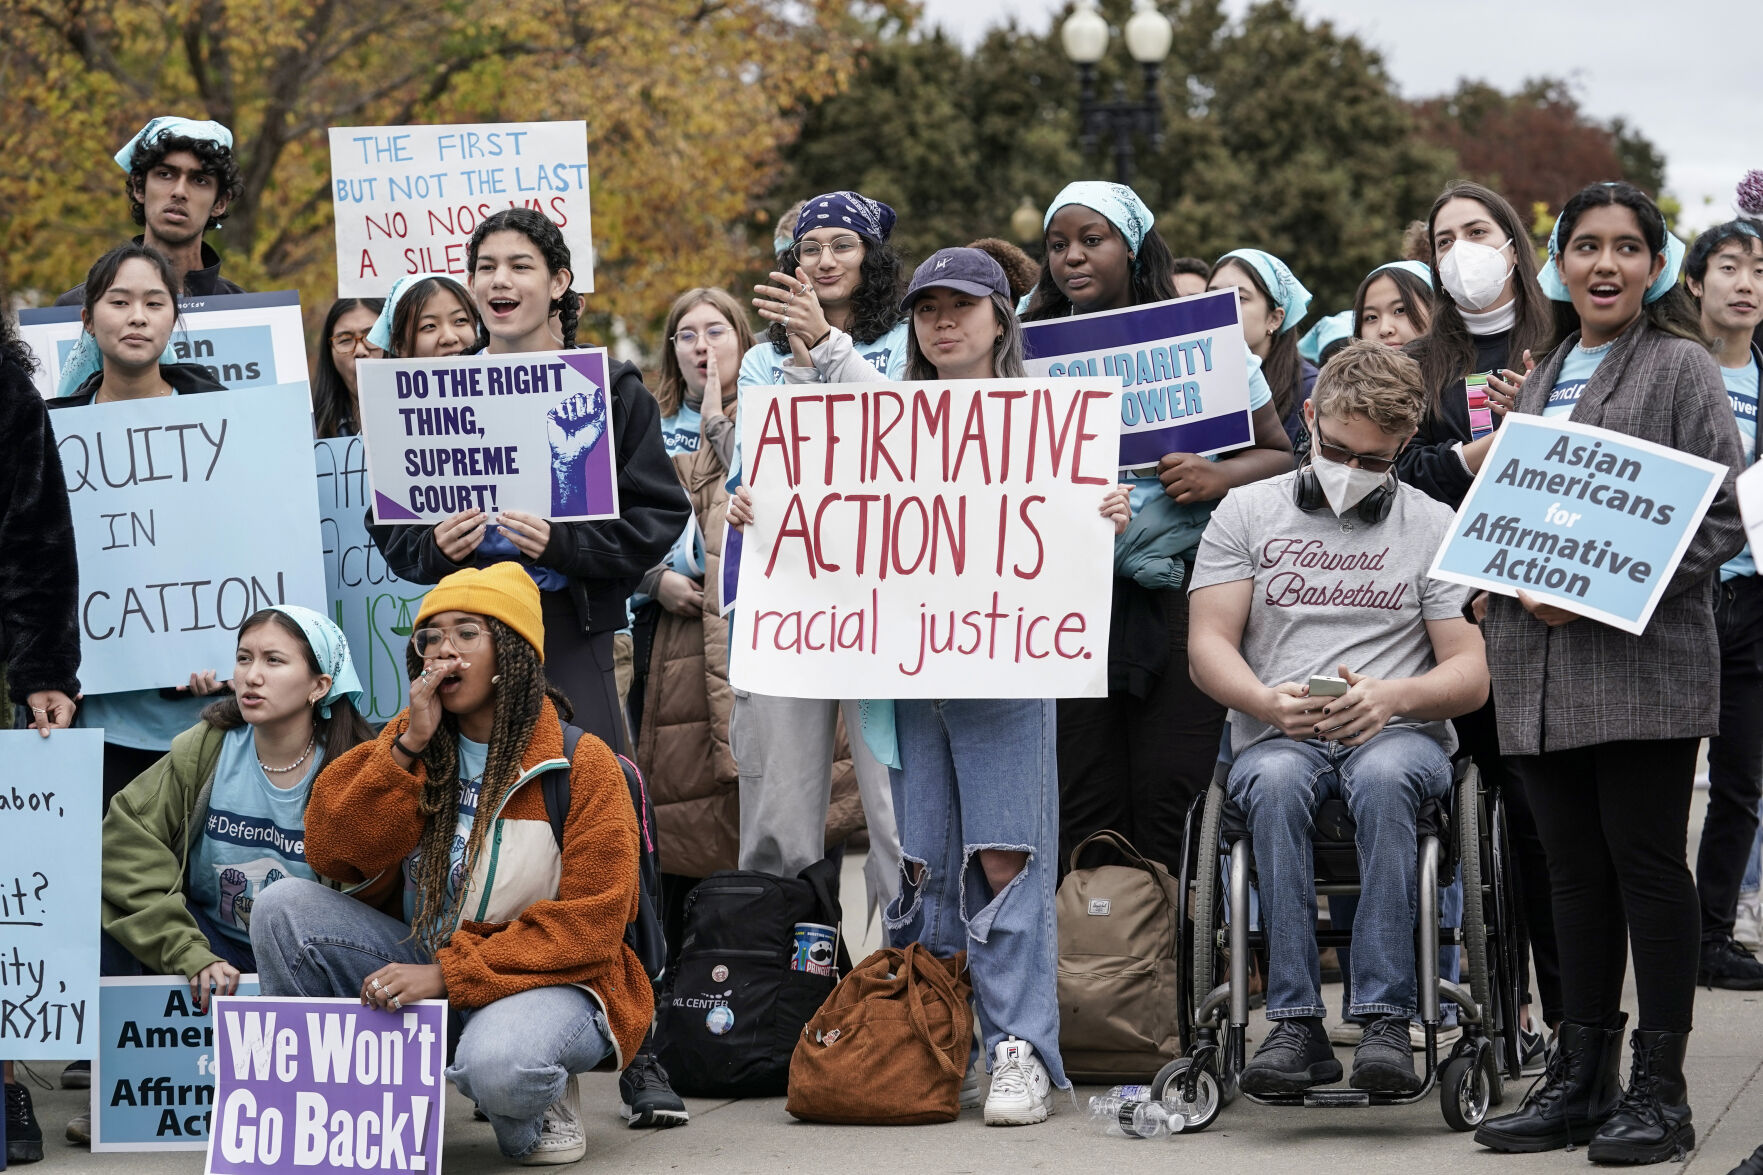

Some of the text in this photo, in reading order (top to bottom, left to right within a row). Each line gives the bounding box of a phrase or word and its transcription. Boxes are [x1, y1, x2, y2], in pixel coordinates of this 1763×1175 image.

[353, 132, 528, 164] THE FIRST
[336, 163, 587, 203] BUT NOT THE LAST
[365, 211, 408, 240] NO
[360, 242, 471, 278] A SILE
[395, 363, 567, 399] DO THE RIGHT
[399, 406, 485, 440] THING,
[749, 388, 1114, 489] AFFIRMATIVE
[404, 446, 519, 477] SUPREME
[1544, 434, 1642, 483] Asian
[409, 484, 499, 513] COURT!
[1495, 457, 1676, 526] Americans
[100, 508, 156, 551] IN
[1544, 502, 1582, 528] for
[764, 492, 1046, 581] ACTION IS
[1260, 538, 1390, 571] Harvard
[1462, 511, 1652, 584] Affirmative
[1265, 571, 1409, 611] Basketball
[1483, 548, 1592, 598] Action
[751, 587, 1093, 676] racial justice.
[686, 997, 729, 1009] CENTER
[224, 1011, 436, 1087] We Won't
[221, 1088, 430, 1171] Go Back!
